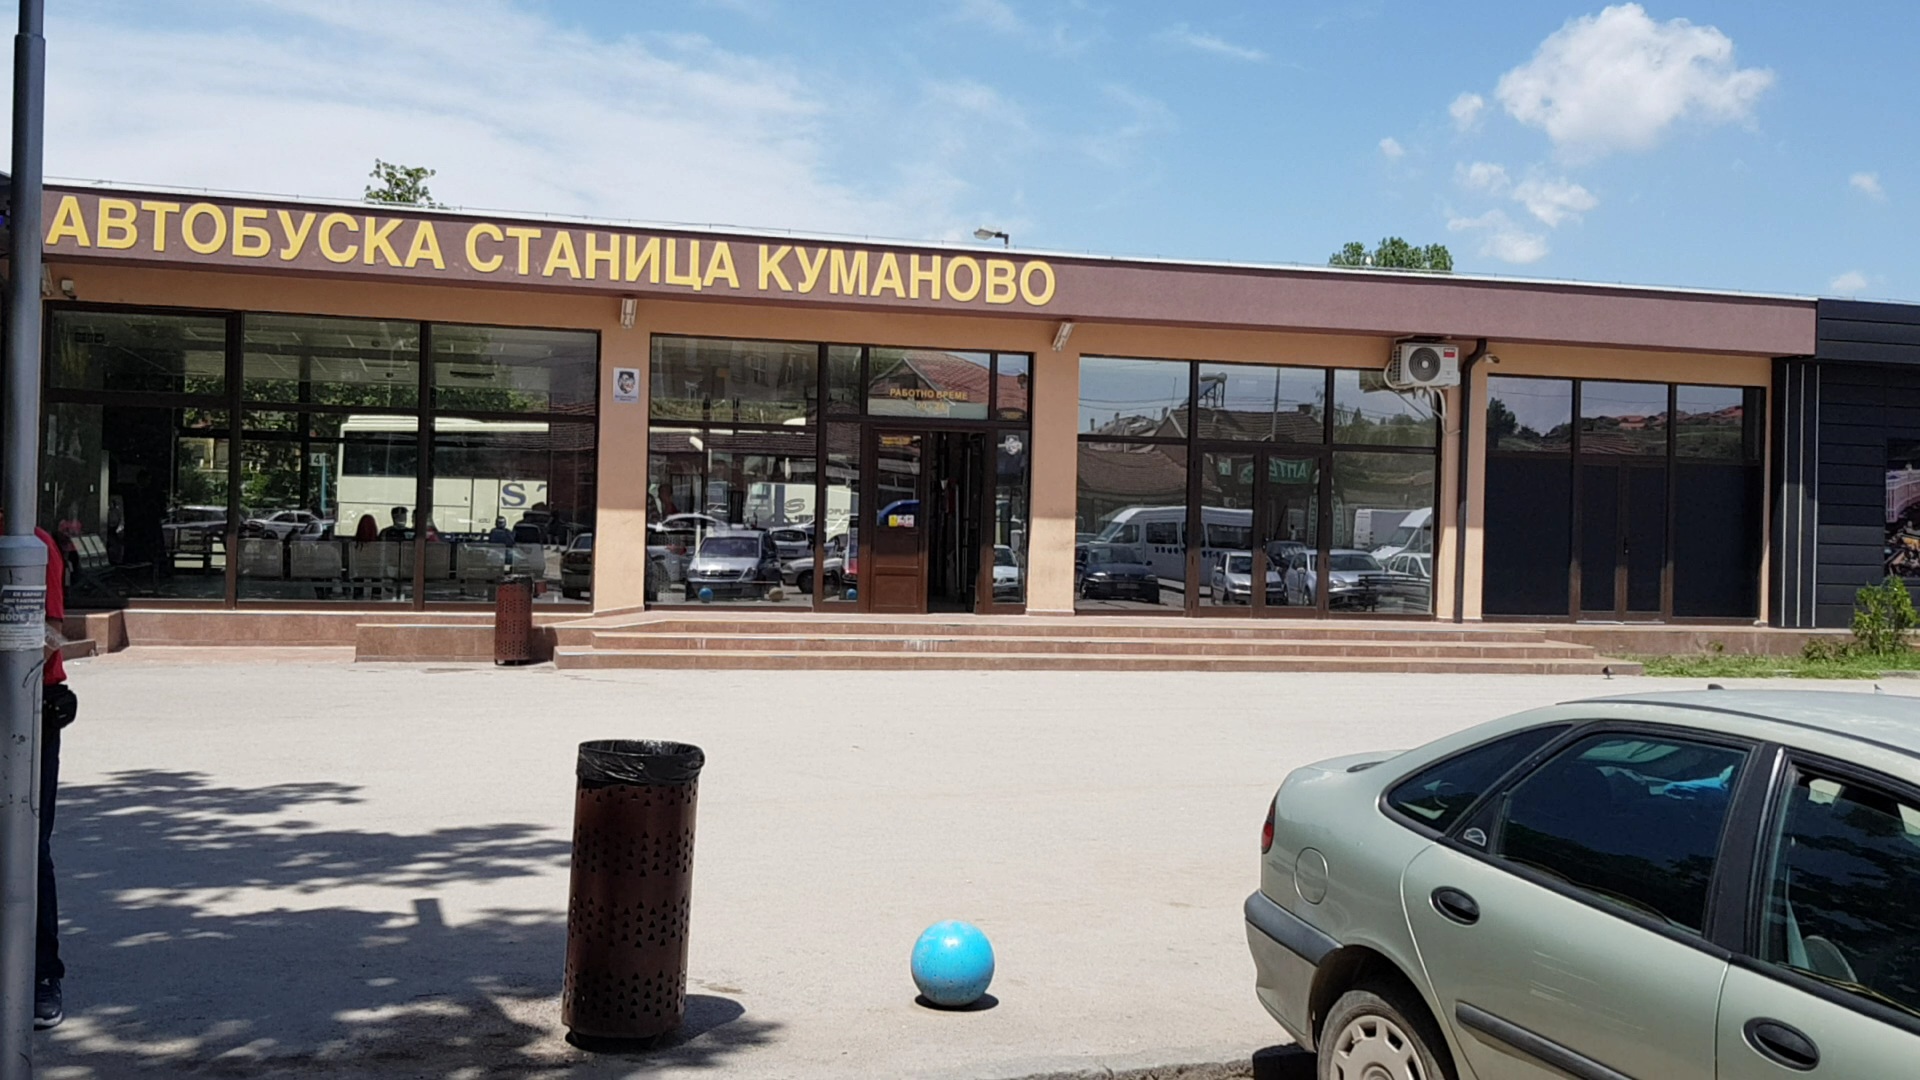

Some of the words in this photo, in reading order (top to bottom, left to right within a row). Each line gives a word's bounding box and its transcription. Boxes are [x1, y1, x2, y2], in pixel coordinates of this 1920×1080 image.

[47, 197, 445, 268] АВТОБУСКА
[467, 224, 739, 291] СТАНИЦА
[760, 245, 1055, 305] КУМАНОВО
[889, 388, 934, 399] РАБОТНО
[936, 391, 968, 400] ВРЕМЕ
[313, 454, 321, 465] 4
